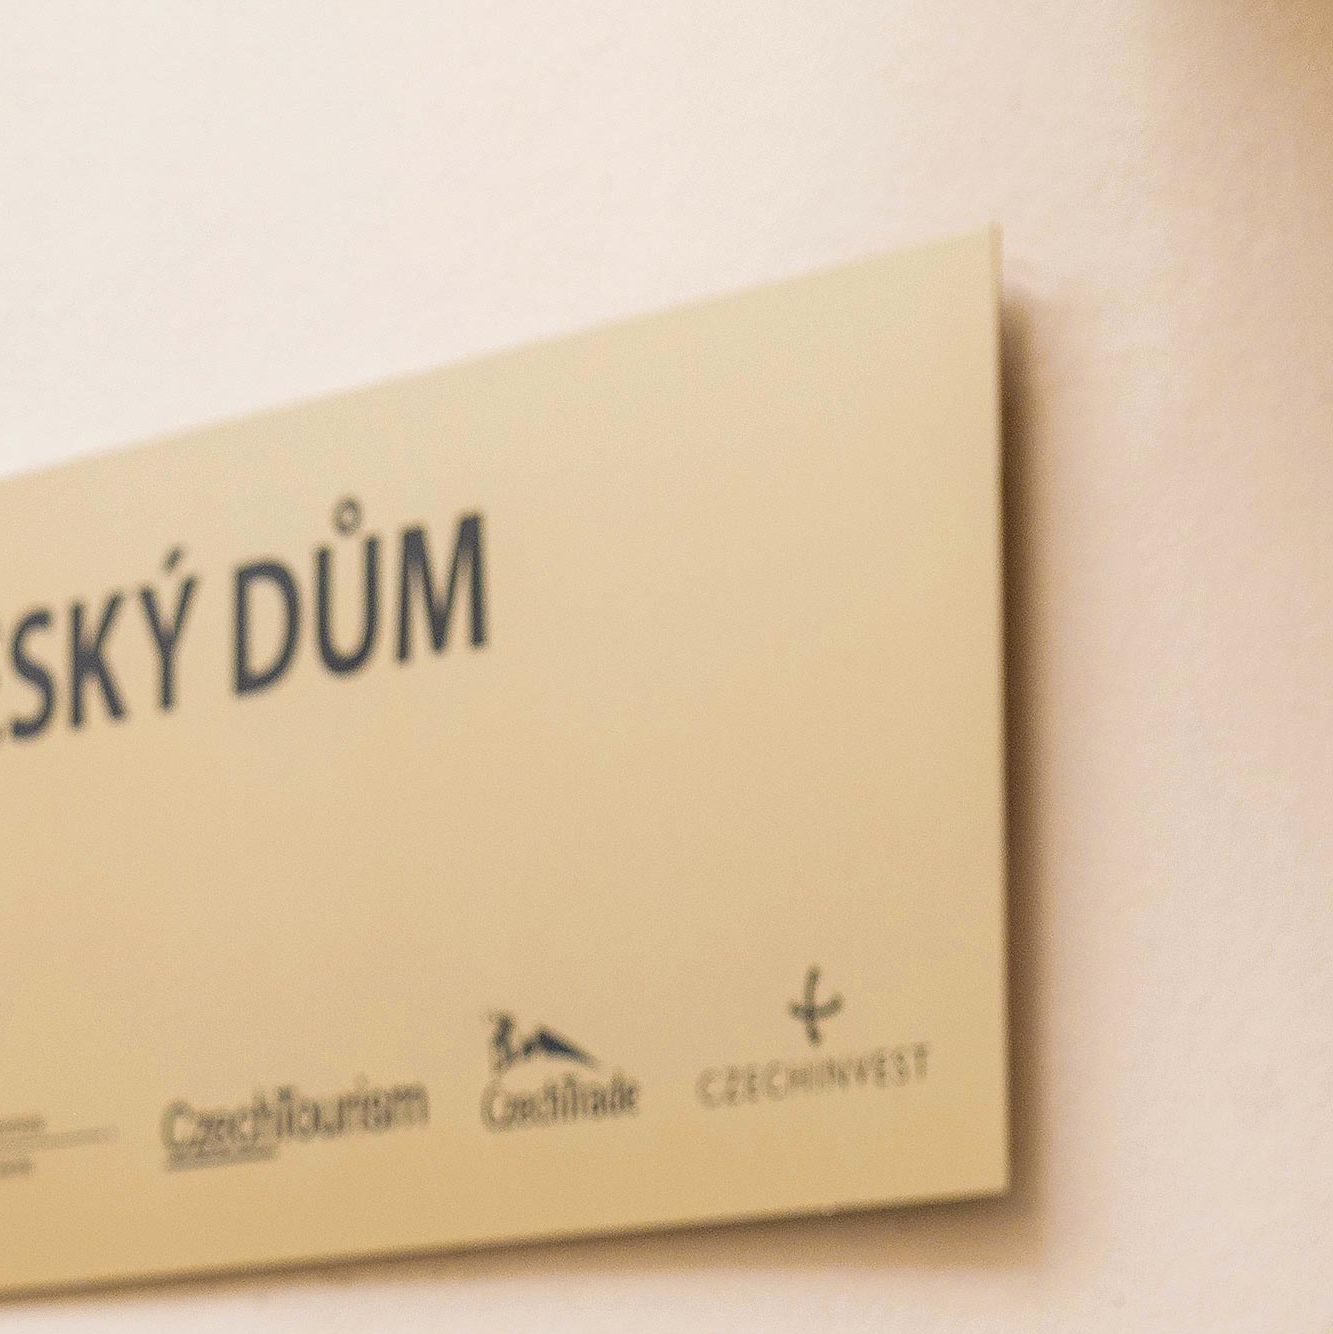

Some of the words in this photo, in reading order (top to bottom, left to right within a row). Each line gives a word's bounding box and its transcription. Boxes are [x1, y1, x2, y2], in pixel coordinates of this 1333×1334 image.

[232, 495, 489, 696] DŮM
[694, 1042, 930, 1108] CZECHINVEST
[162, 1076, 430, 1151] CzechTourism
